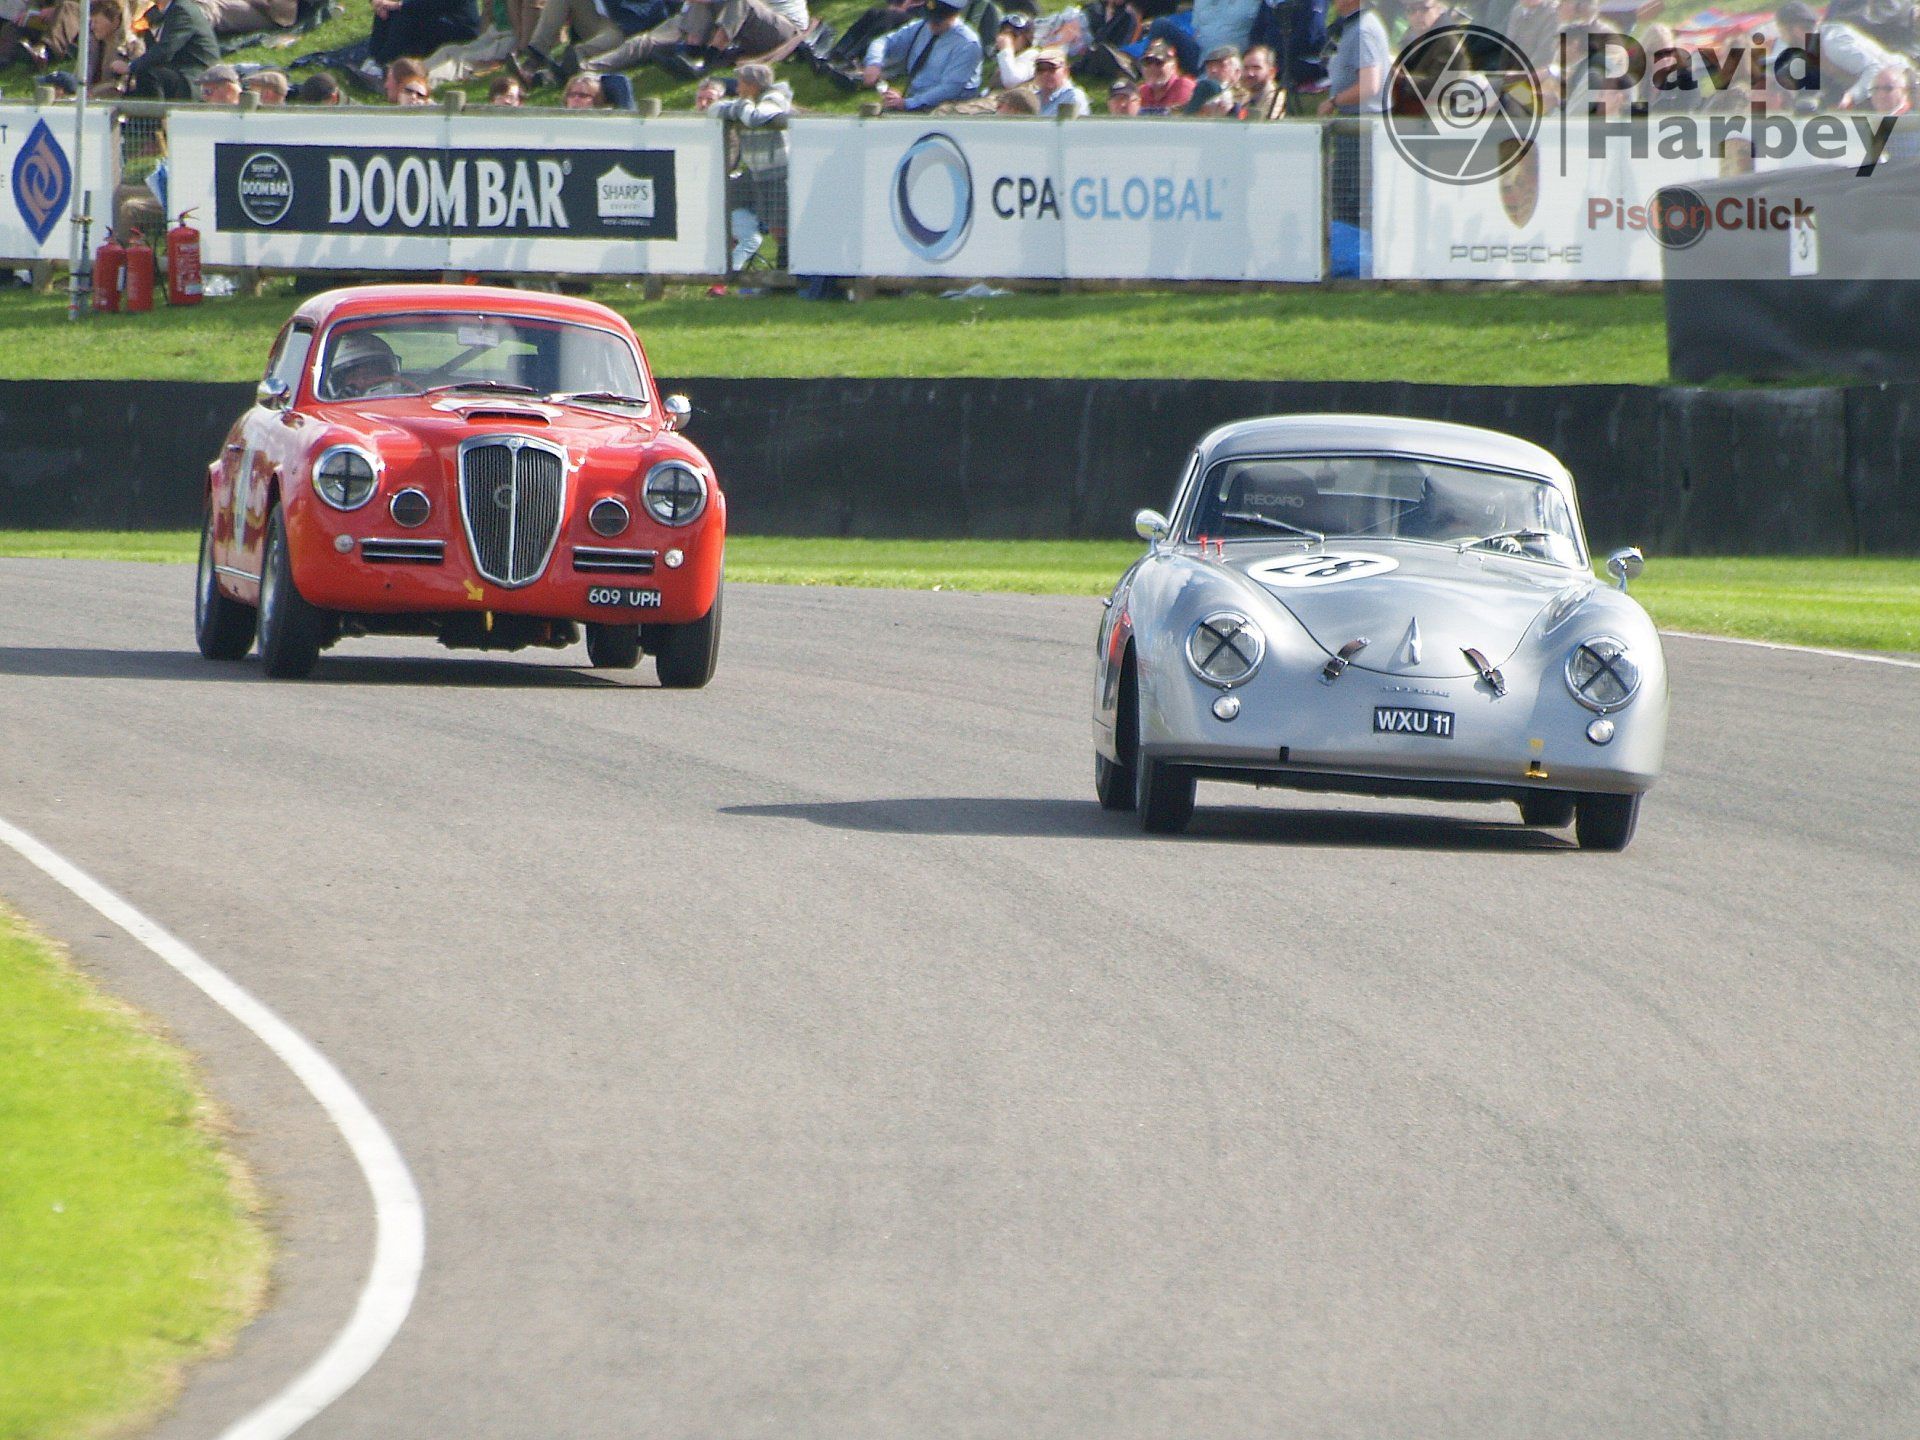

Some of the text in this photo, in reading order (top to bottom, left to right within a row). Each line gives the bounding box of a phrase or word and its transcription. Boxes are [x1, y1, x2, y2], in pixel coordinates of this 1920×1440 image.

[328, 156, 570, 228] DOOM BAR
[602, 184, 648, 201] SHARP'S
[991, 176, 1223, 221] CPA GLOBAL
[1450, 244, 1583, 264] PORSCHE
[1799, 229, 1809, 261] 3
[1243, 493, 1304, 508] RECARO
[1263, 555, 1381, 578] 28
[588, 588, 662, 607] 609 UPH
[1377, 710, 1451, 735] WXU 11
